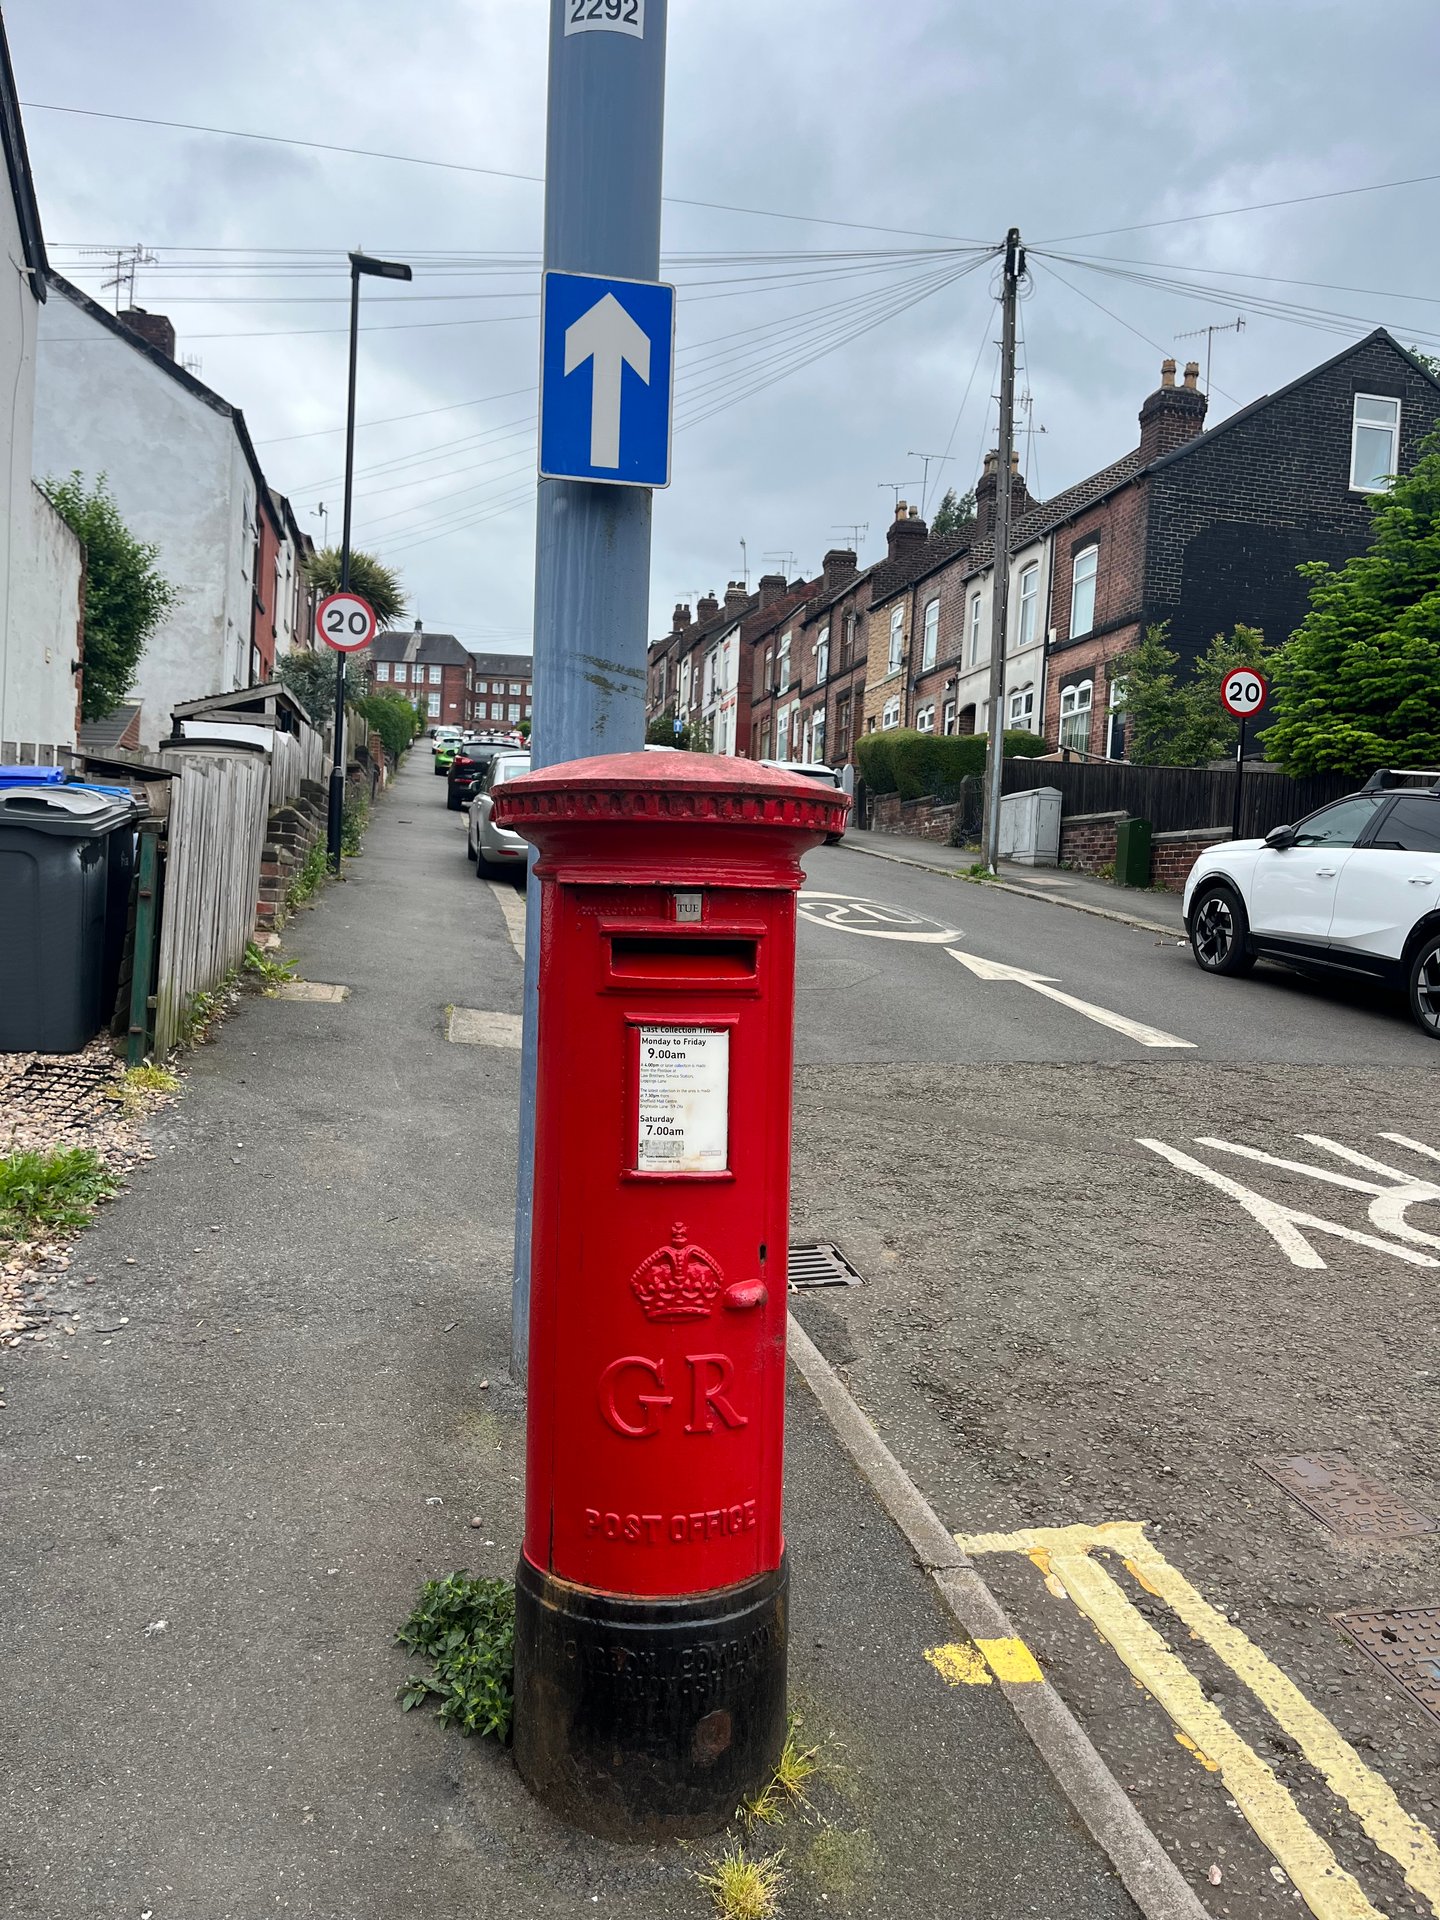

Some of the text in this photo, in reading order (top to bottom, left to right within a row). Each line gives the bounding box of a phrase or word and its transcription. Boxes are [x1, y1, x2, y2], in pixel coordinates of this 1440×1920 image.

[571, 0, 638, 25] 2292
[327, 609, 367, 635] 20
[1229, 682, 1260, 702] 20
[677, 903, 699, 913] TUE
[799, 902, 923, 924] 20
[641, 1026, 658, 1034] Last
[660, 1026, 697, 1034] Collection
[641, 1037, 671, 1047] Monday
[683, 1038, 707, 1047] Friday
[647, 1047, 686, 1059] 9.00am
[640, 1114, 675, 1124] Saturday
[646, 1124, 684, 1136] 7.00am
[585, 1500, 756, 1542] POST OFFICE
